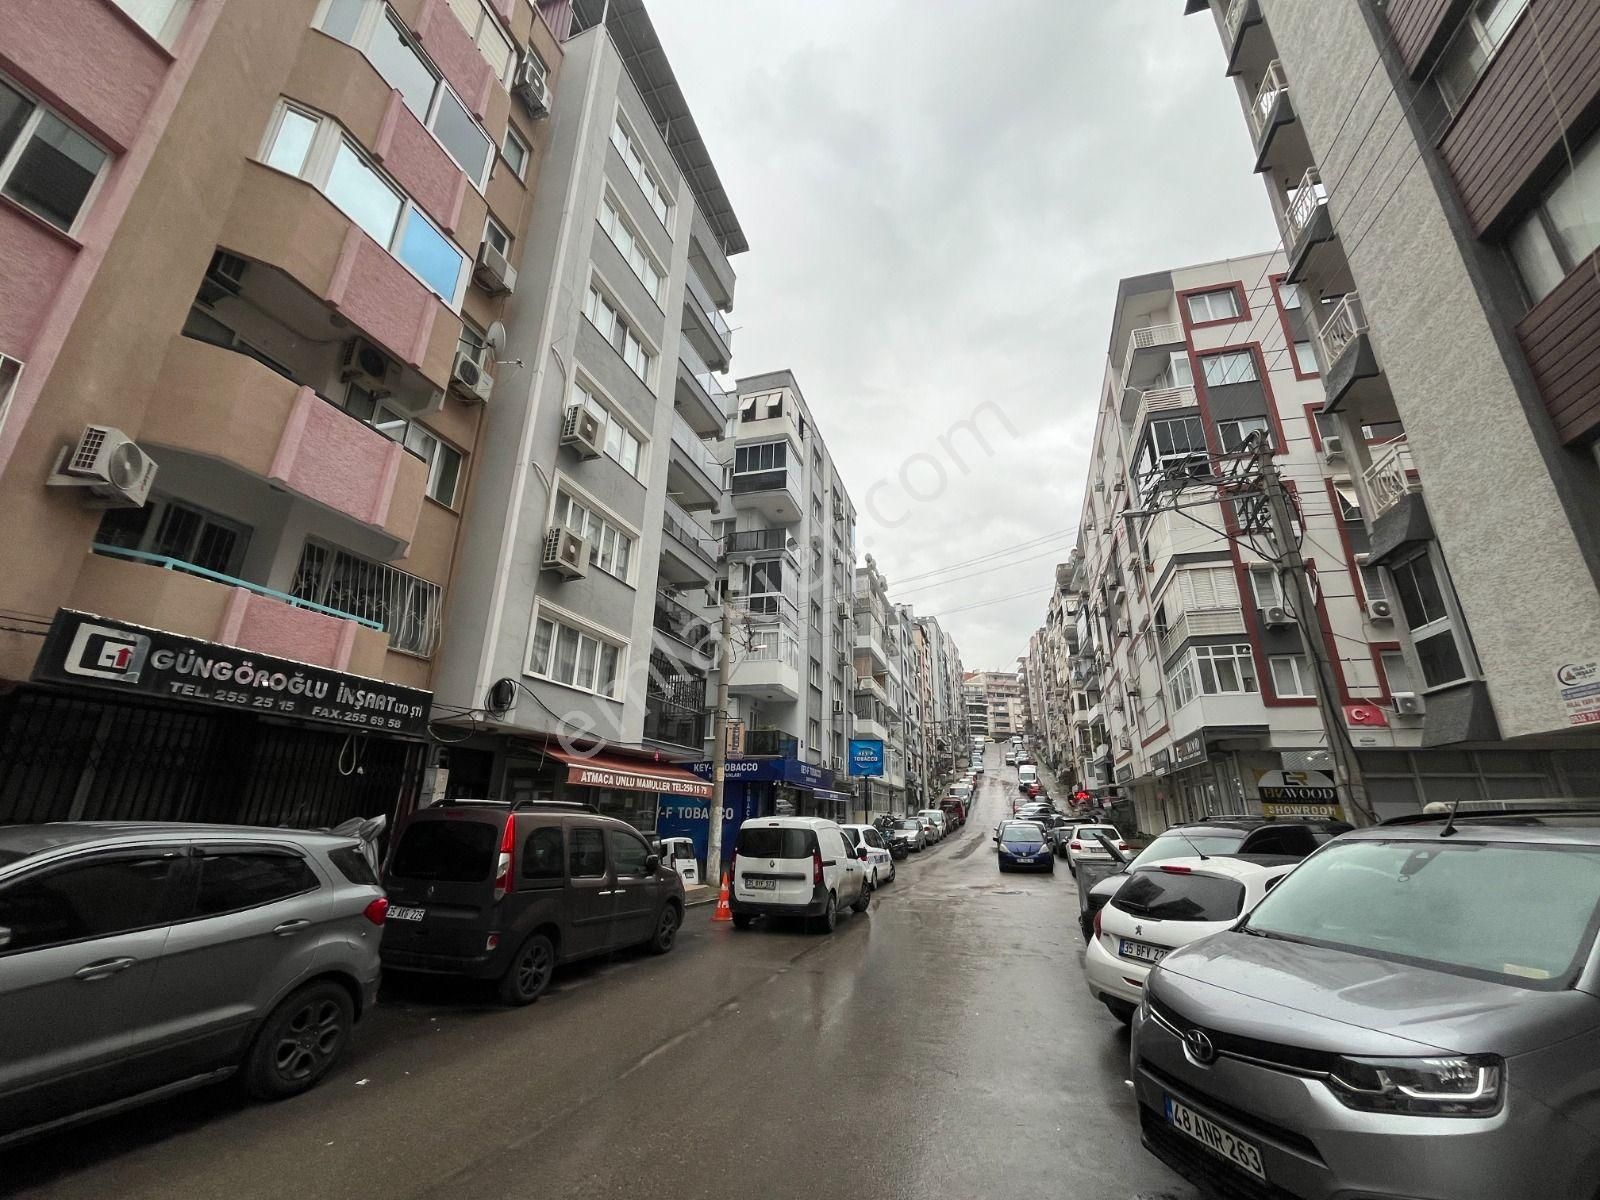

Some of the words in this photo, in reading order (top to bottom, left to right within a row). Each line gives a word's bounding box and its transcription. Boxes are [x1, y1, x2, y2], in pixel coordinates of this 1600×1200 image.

[150, 648, 328, 699] GÜNGÖROĞLU
[336, 682, 396, 711] İNŞAAT
[214, 689, 249, 704] 255
[252, 696, 274, 708] 25
[279, 701, 295, 711] 15
[343, 712, 367, 723] 255
[370, 716, 384, 726] 69
[387, 719, 402, 728] 58
[693, 763, 713, 772] KEY-
[724, 762, 758, 772] OBACCO
[581, 771, 614, 785] ATMACA
[1269, 805, 1336, 816] SHOWROOM
[1124, 942, 1134, 954] 35
[1174, 1104, 1191, 1131] 48
[1194, 1115, 1226, 1153] ANR
[1225, 1134, 1262, 1174] 263
